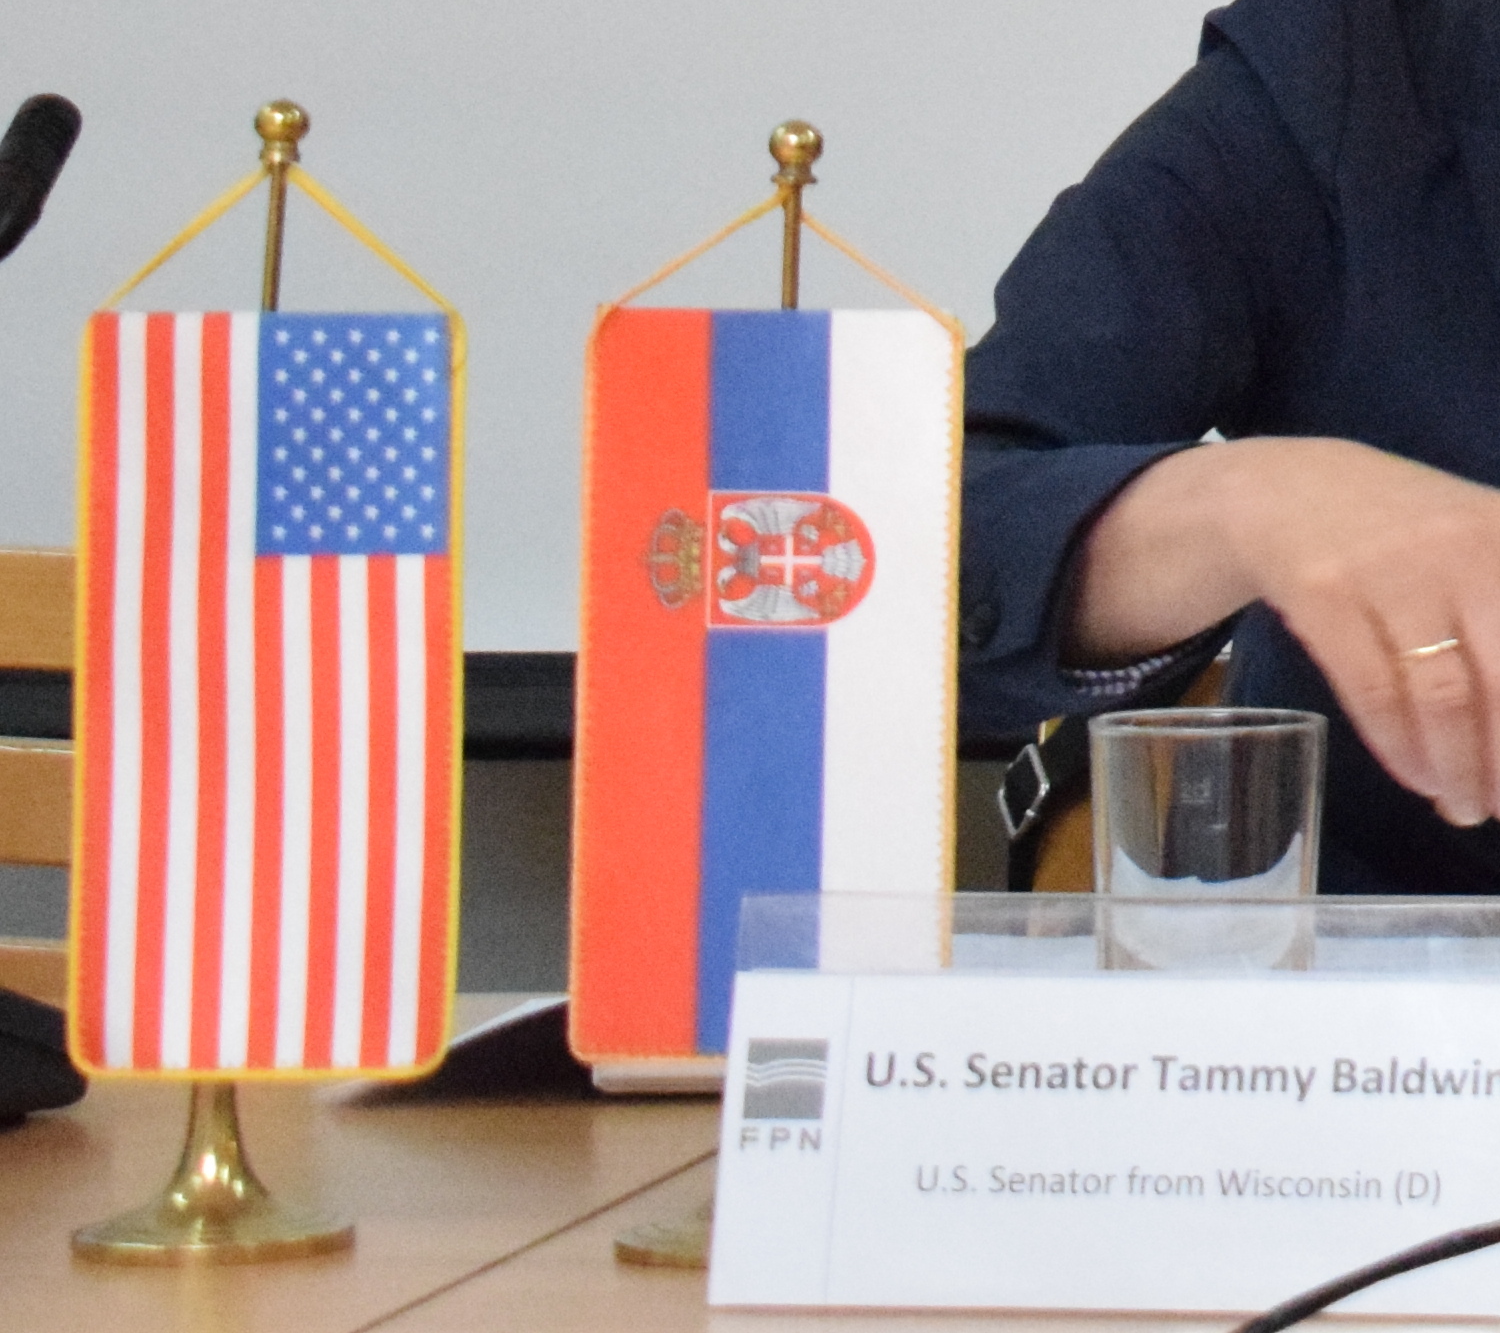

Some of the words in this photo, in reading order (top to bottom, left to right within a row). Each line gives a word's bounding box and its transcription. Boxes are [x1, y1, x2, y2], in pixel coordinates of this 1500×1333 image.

[864, 1051, 948, 1090] U.S.
[963, 1052, 1138, 1092] Senator
[1151, 1054, 1317, 1102] Tammy
[914, 1163, 977, 1196] U.S.
[987, 1164, 1117, 1197] Senator
[1126, 1164, 1206, 1198] from
[1216, 1168, 1384, 1201] Wisconsin
[1393, 1170, 1443, 1207] (D)
